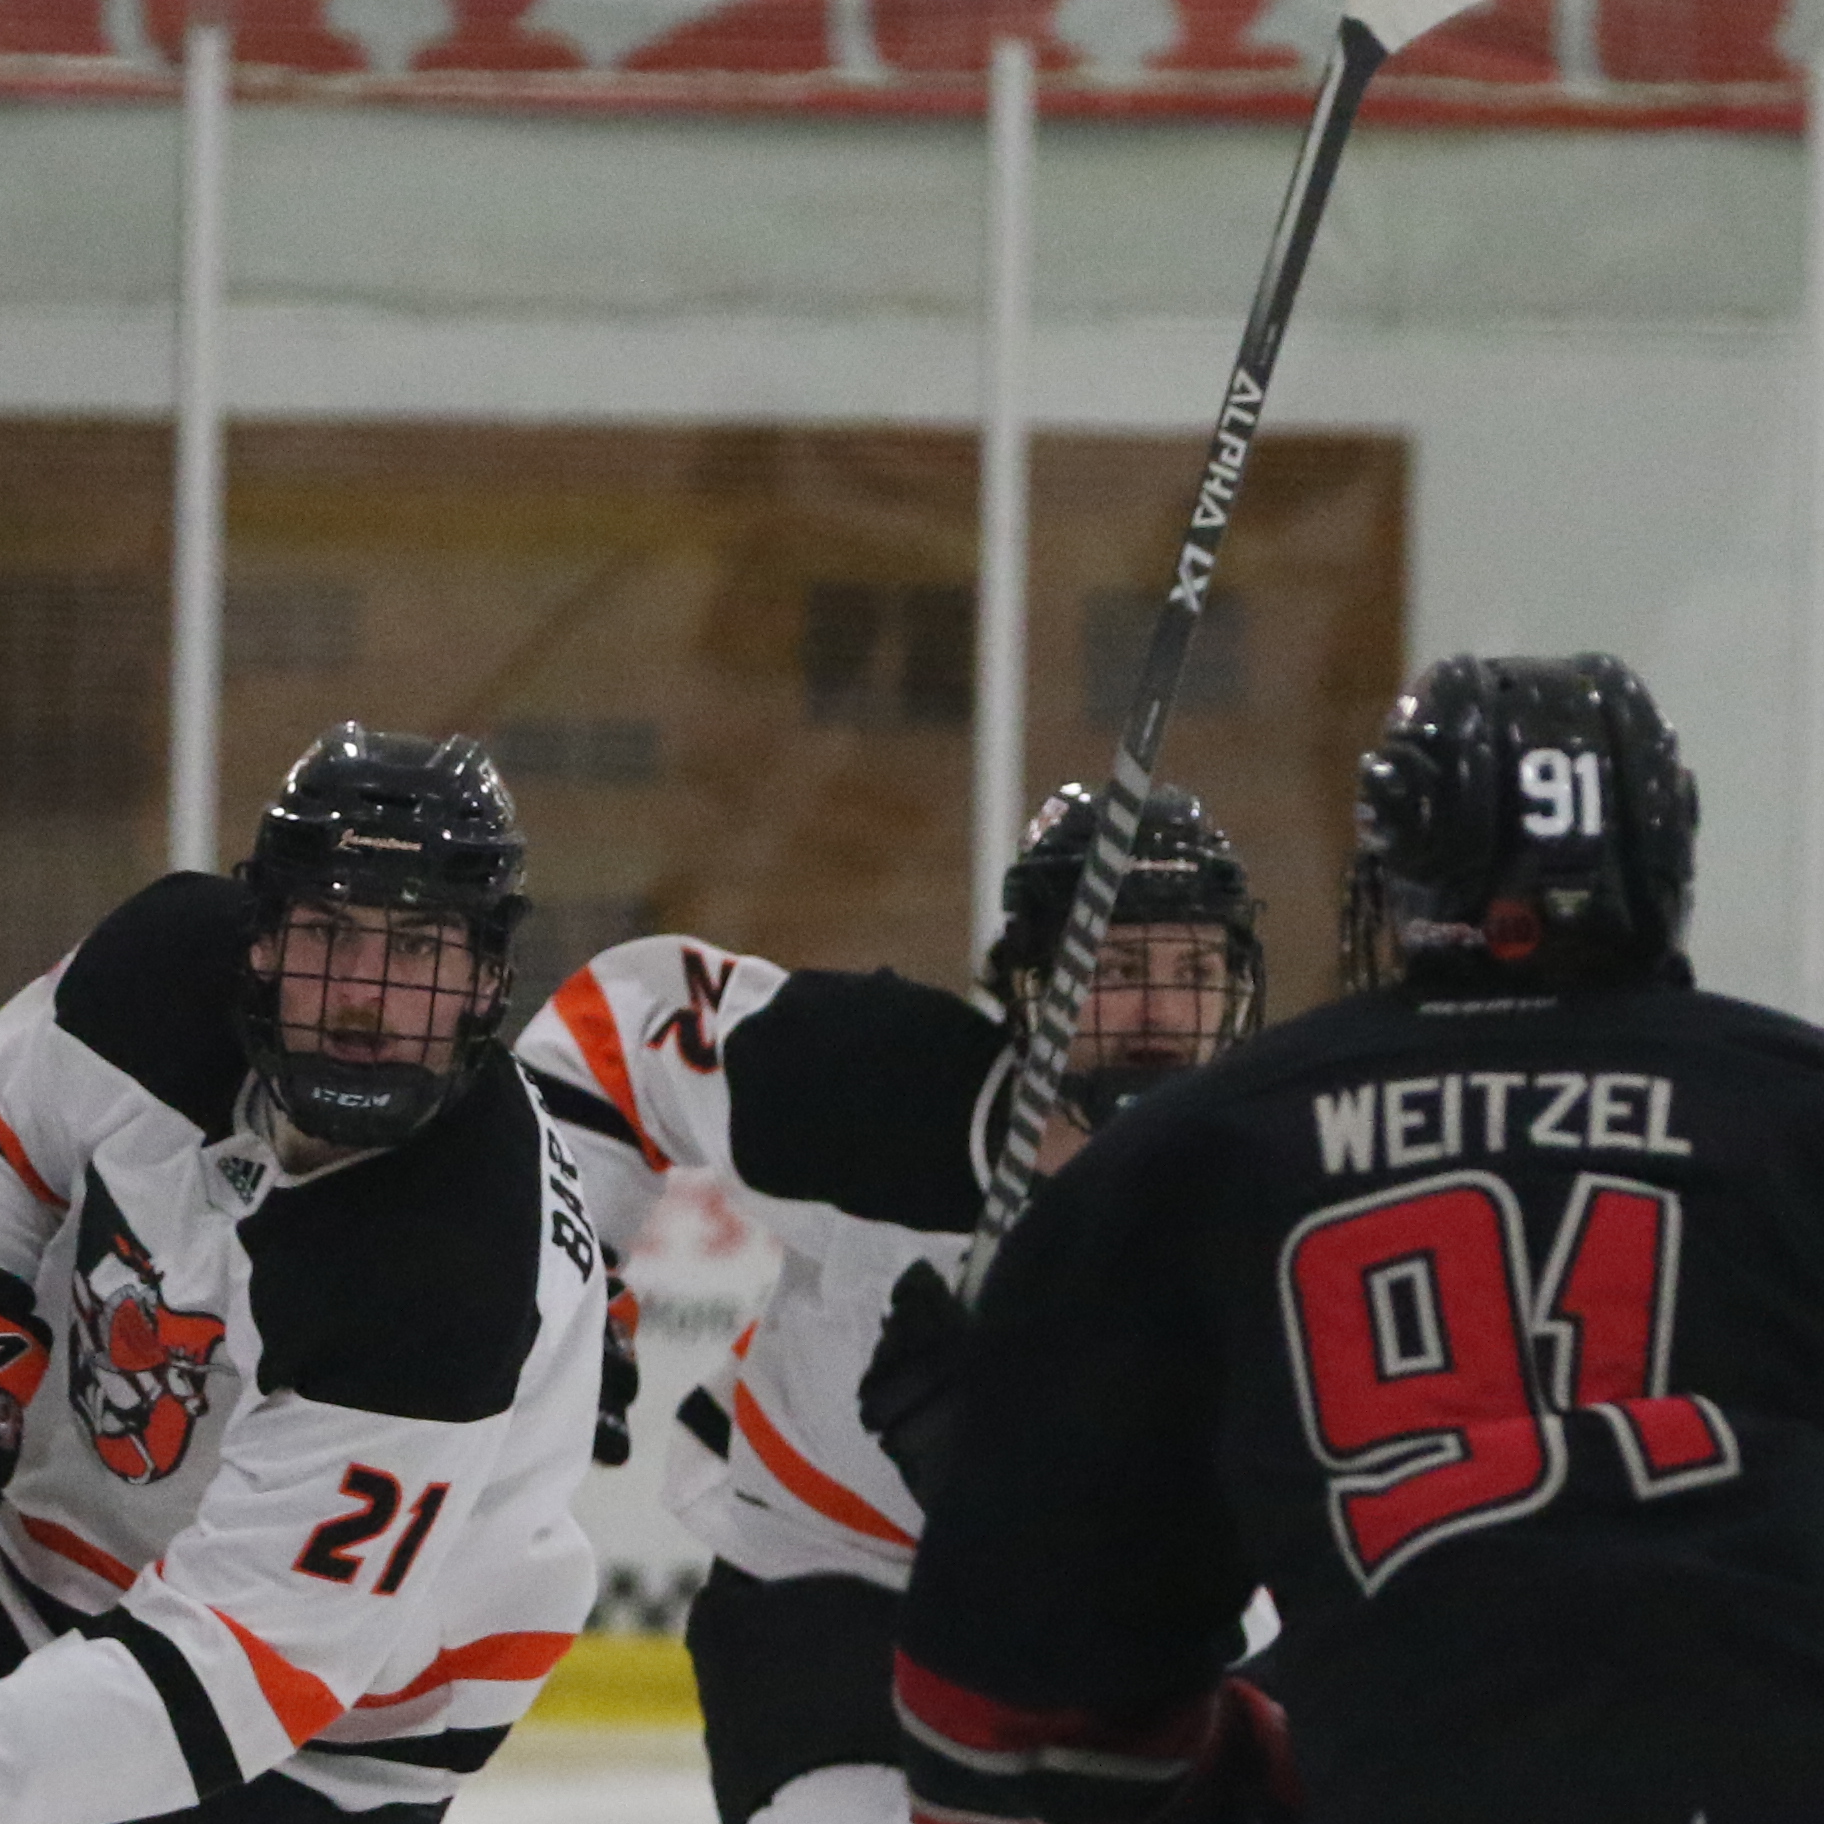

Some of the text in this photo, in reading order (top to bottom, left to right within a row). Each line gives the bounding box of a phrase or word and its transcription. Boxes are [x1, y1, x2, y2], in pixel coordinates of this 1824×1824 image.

[1169, 367, 1264, 615] ALPHA LX
[1519, 747, 1603, 837] 91
[1311, 1070, 1693, 1175] WEITZEL
[1278, 1167, 1741, 1598] 91
[291, 1462, 452, 1598] 21
